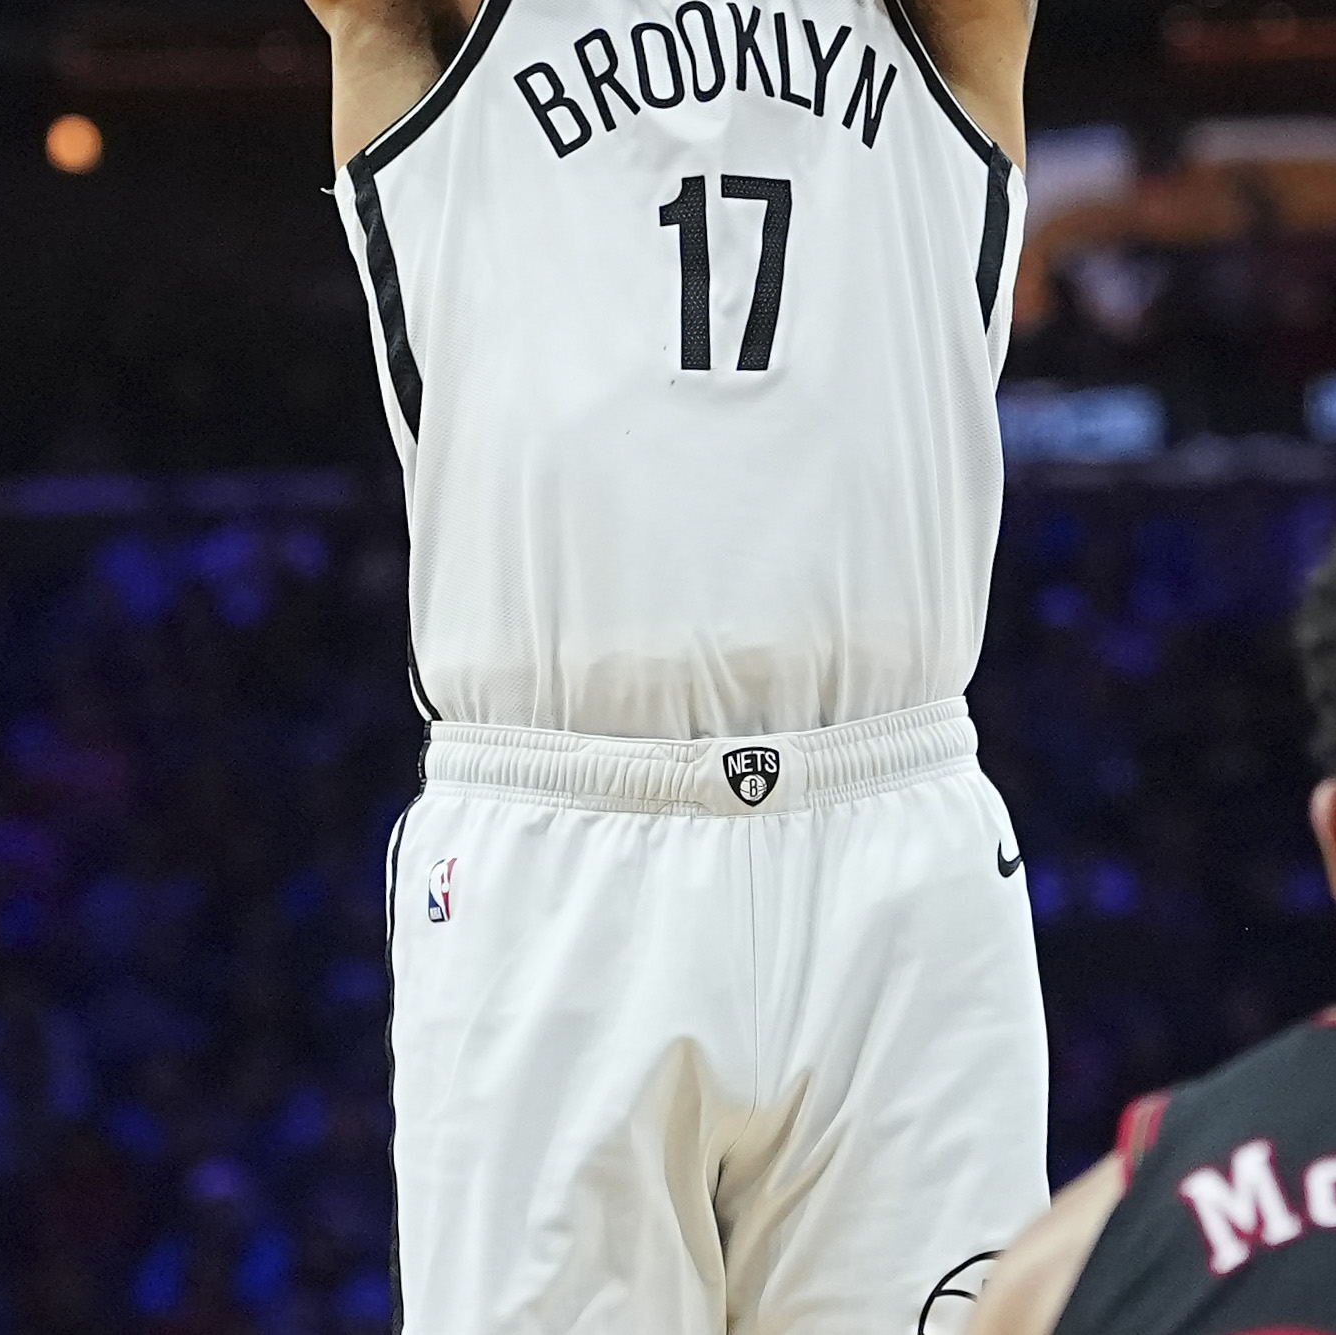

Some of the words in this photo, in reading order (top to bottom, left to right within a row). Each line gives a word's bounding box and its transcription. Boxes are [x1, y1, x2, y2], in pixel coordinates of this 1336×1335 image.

[513, 0, 898, 159] BROOKLYN
[658, 174, 793, 372] 17
[727, 750, 778, 778] NETS
